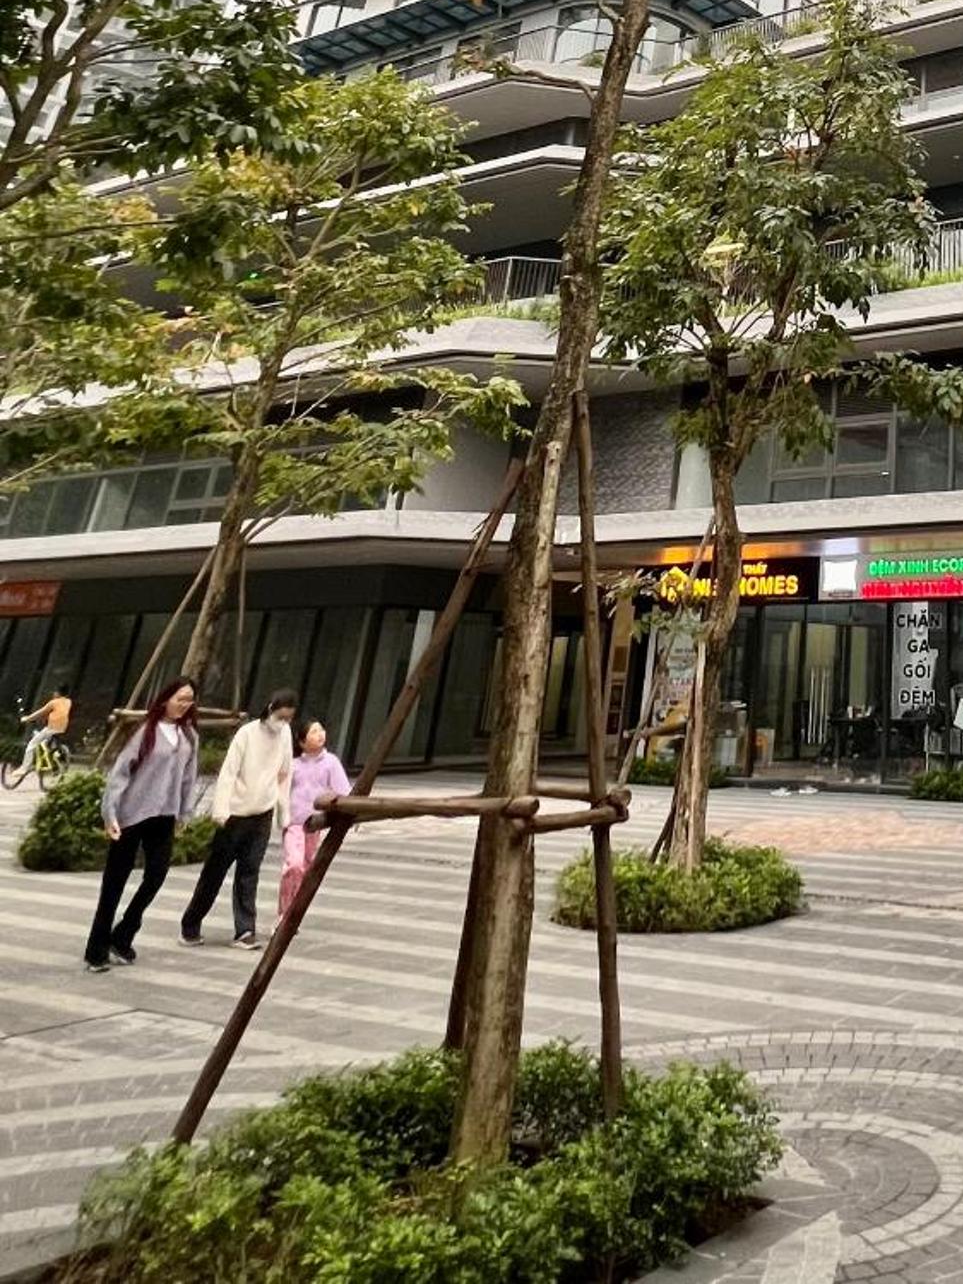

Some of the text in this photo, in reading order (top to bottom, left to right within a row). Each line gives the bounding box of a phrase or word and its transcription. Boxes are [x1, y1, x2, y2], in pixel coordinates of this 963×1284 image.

[898, 560, 929, 573] XINH
[896, 608, 941, 628] CHĂN
[907, 639, 930, 653] GA
[903, 657, 931, 679] GỐI
[899, 686, 935, 707] ĐỆM
